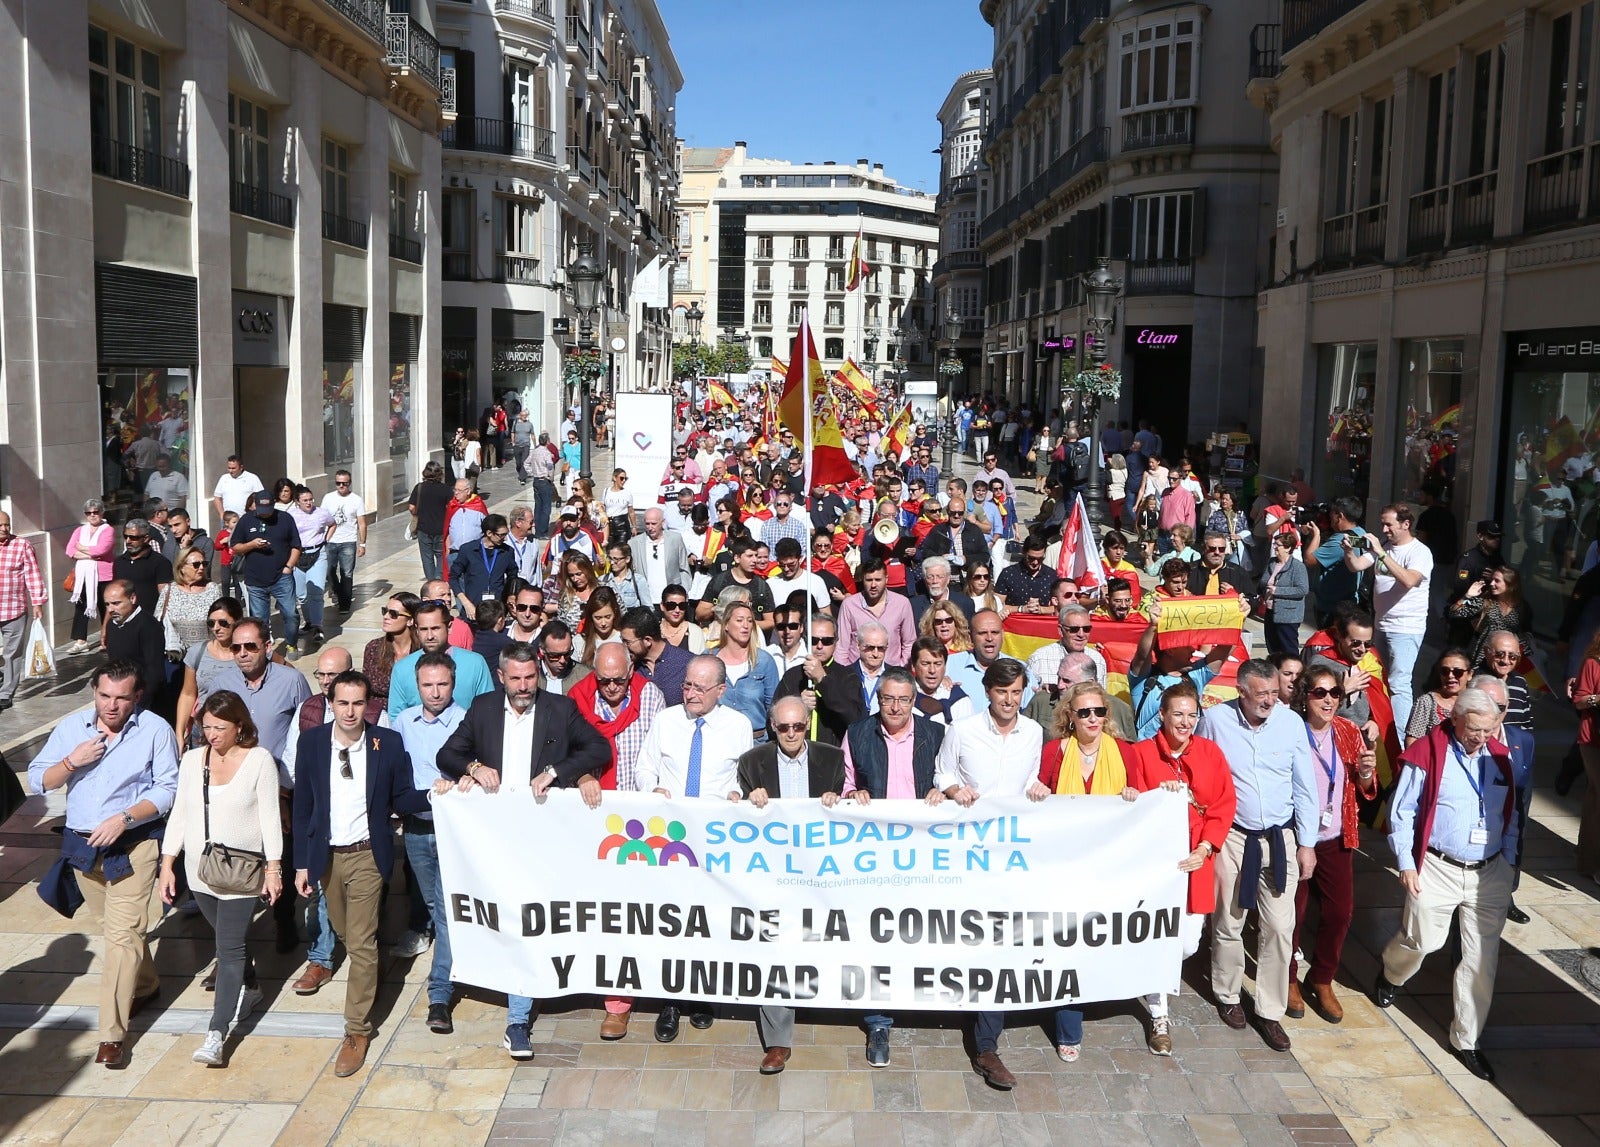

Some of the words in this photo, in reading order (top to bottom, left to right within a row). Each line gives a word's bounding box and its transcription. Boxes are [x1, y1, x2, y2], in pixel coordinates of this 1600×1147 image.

[238, 308, 274, 334] COS
[1136, 330, 1178, 344] Etam
[1518, 343, 1545, 356] Pull
[1547, 344, 1577, 356] and
[497, 351, 542, 362] SWAROVSKI
[705, 819, 914, 848] SOCIEDAD
[928, 815, 1032, 844] CIVIL
[705, 844, 1030, 877] MALAGUEÑA
[776, 874, 963, 888] sociedadcivilmalaga@gmail.com
[451, 893, 500, 932] EN
[521, 900, 711, 938] DEFENSA
[730, 906, 780, 942] DE
[802, 908, 850, 942] LA
[870, 900, 1180, 947] CONSTITUCIÓN
[551, 954, 576, 989] Y
[595, 954, 642, 990] LA
[661, 958, 819, 1000] UNIDAD
[841, 964, 891, 1001] DE
[913, 958, 1081, 1005] ESPAÑA
